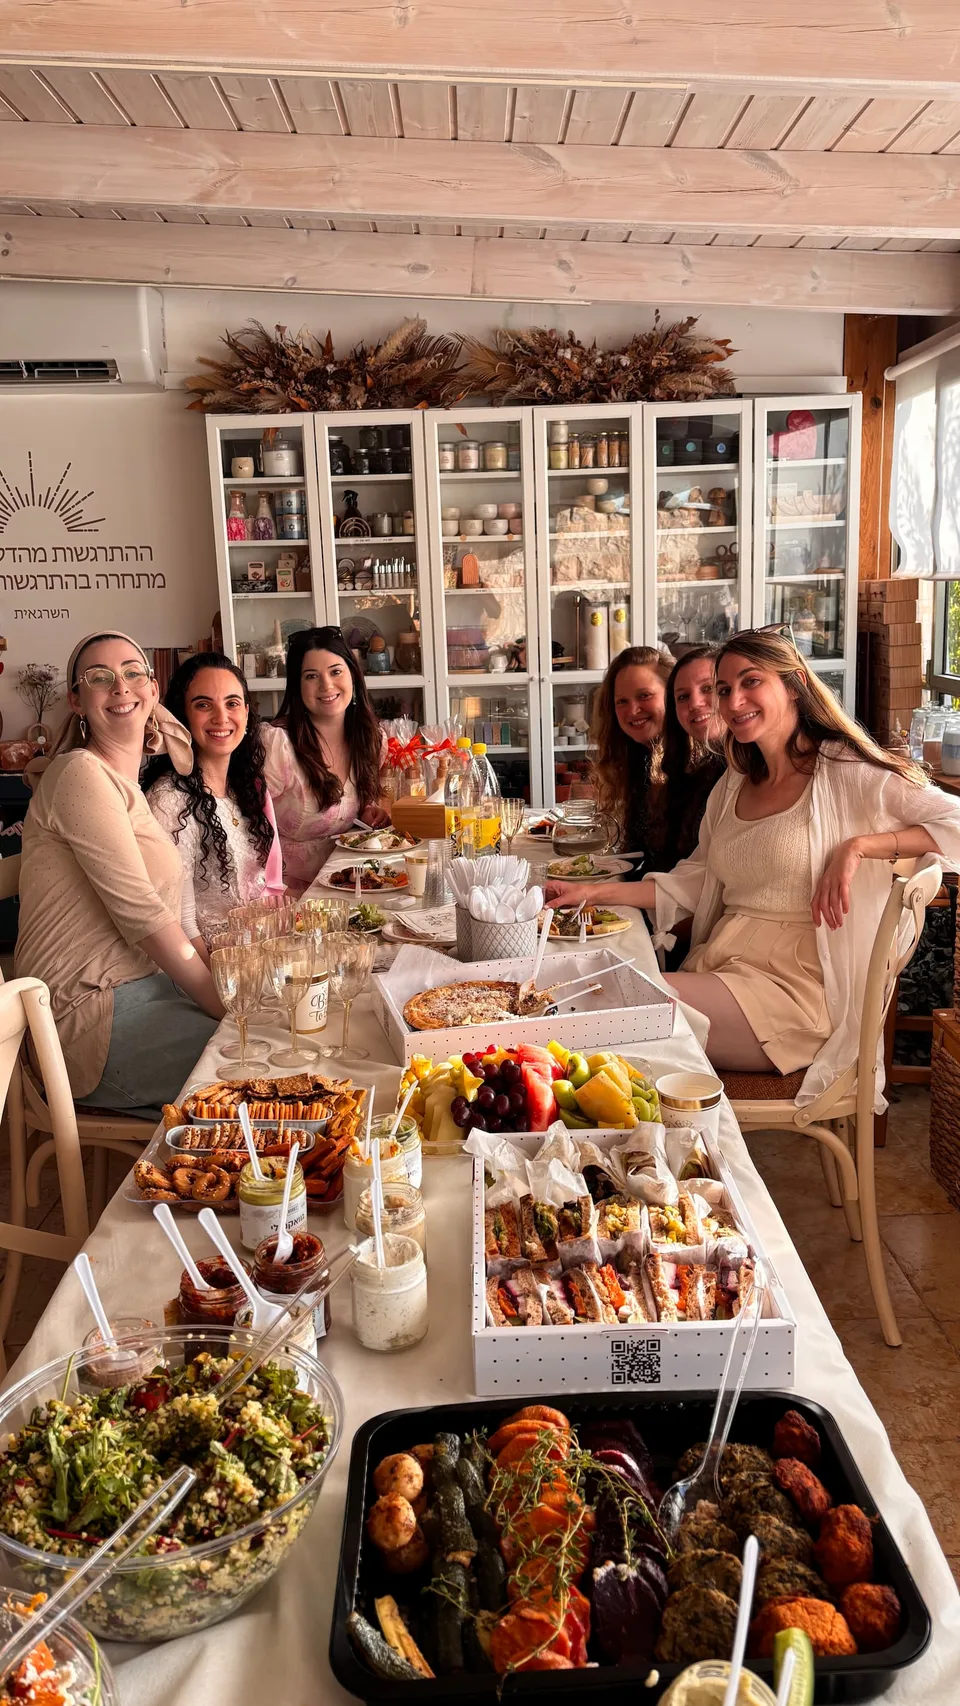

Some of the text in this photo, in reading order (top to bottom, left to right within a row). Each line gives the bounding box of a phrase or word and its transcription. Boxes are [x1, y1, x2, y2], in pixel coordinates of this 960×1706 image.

[52, 545, 153, 563] ההתרגשות
[95, 572, 166, 589] מתחרה
[14, 608, 70, 619] השרגאית
